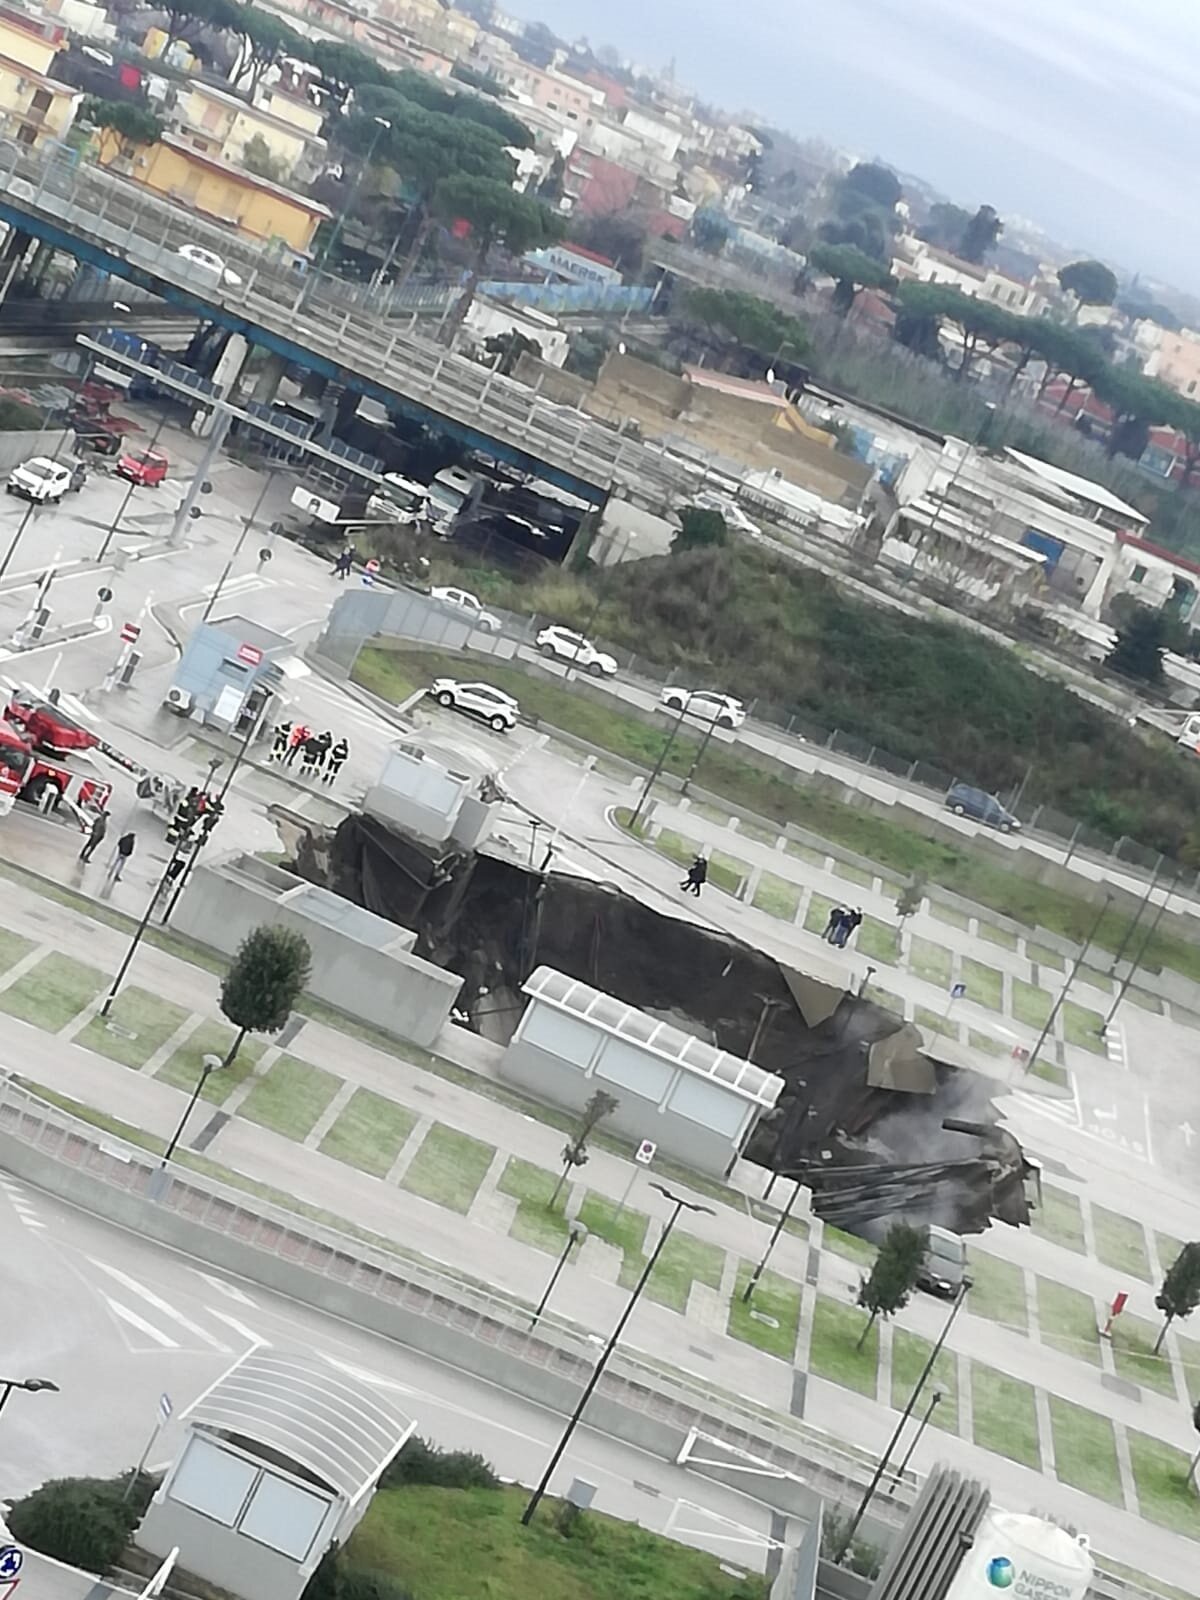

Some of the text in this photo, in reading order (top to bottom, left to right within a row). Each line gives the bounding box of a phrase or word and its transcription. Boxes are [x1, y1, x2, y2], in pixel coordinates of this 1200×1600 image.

[550, 254, 606, 286] MAERSK
[1014, 1582, 1062, 1600] GAS
[1019, 1570, 1072, 1598] NIPPON
